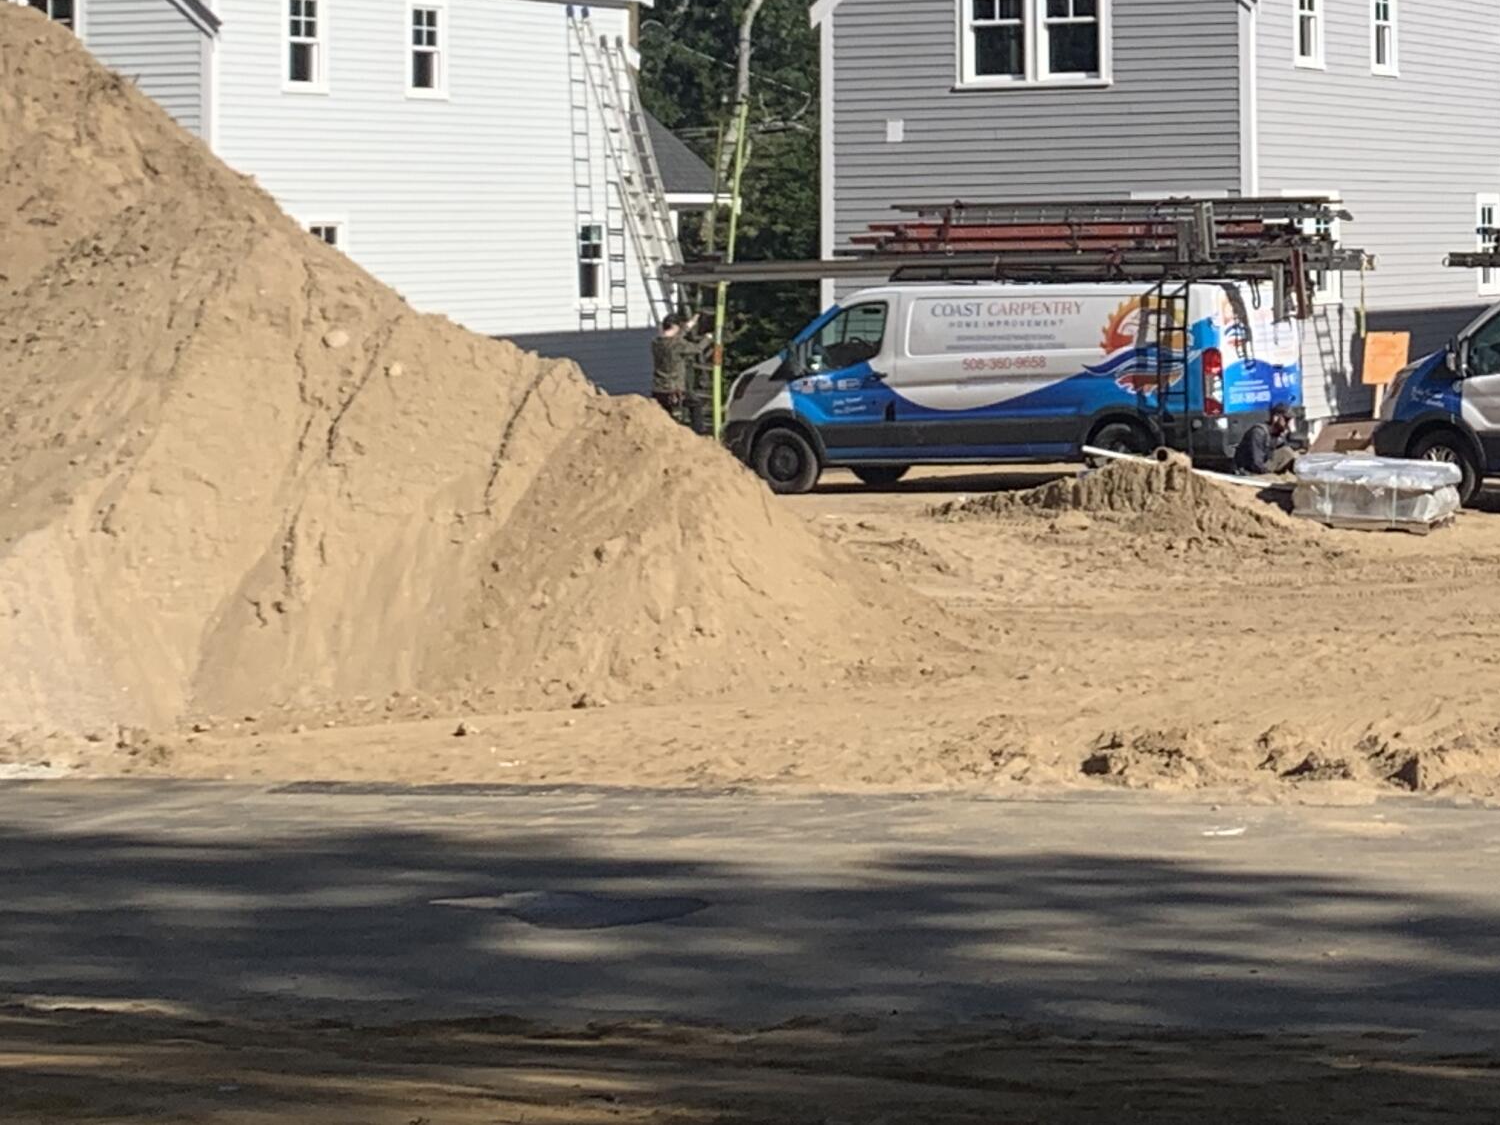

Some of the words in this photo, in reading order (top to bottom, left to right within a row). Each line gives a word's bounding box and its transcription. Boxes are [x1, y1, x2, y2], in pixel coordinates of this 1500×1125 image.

[931, 302, 983, 318] COAST
[987, 301, 1085, 317] CARPENTRY
[961, 355, 1047, 372] 508-360-9658
